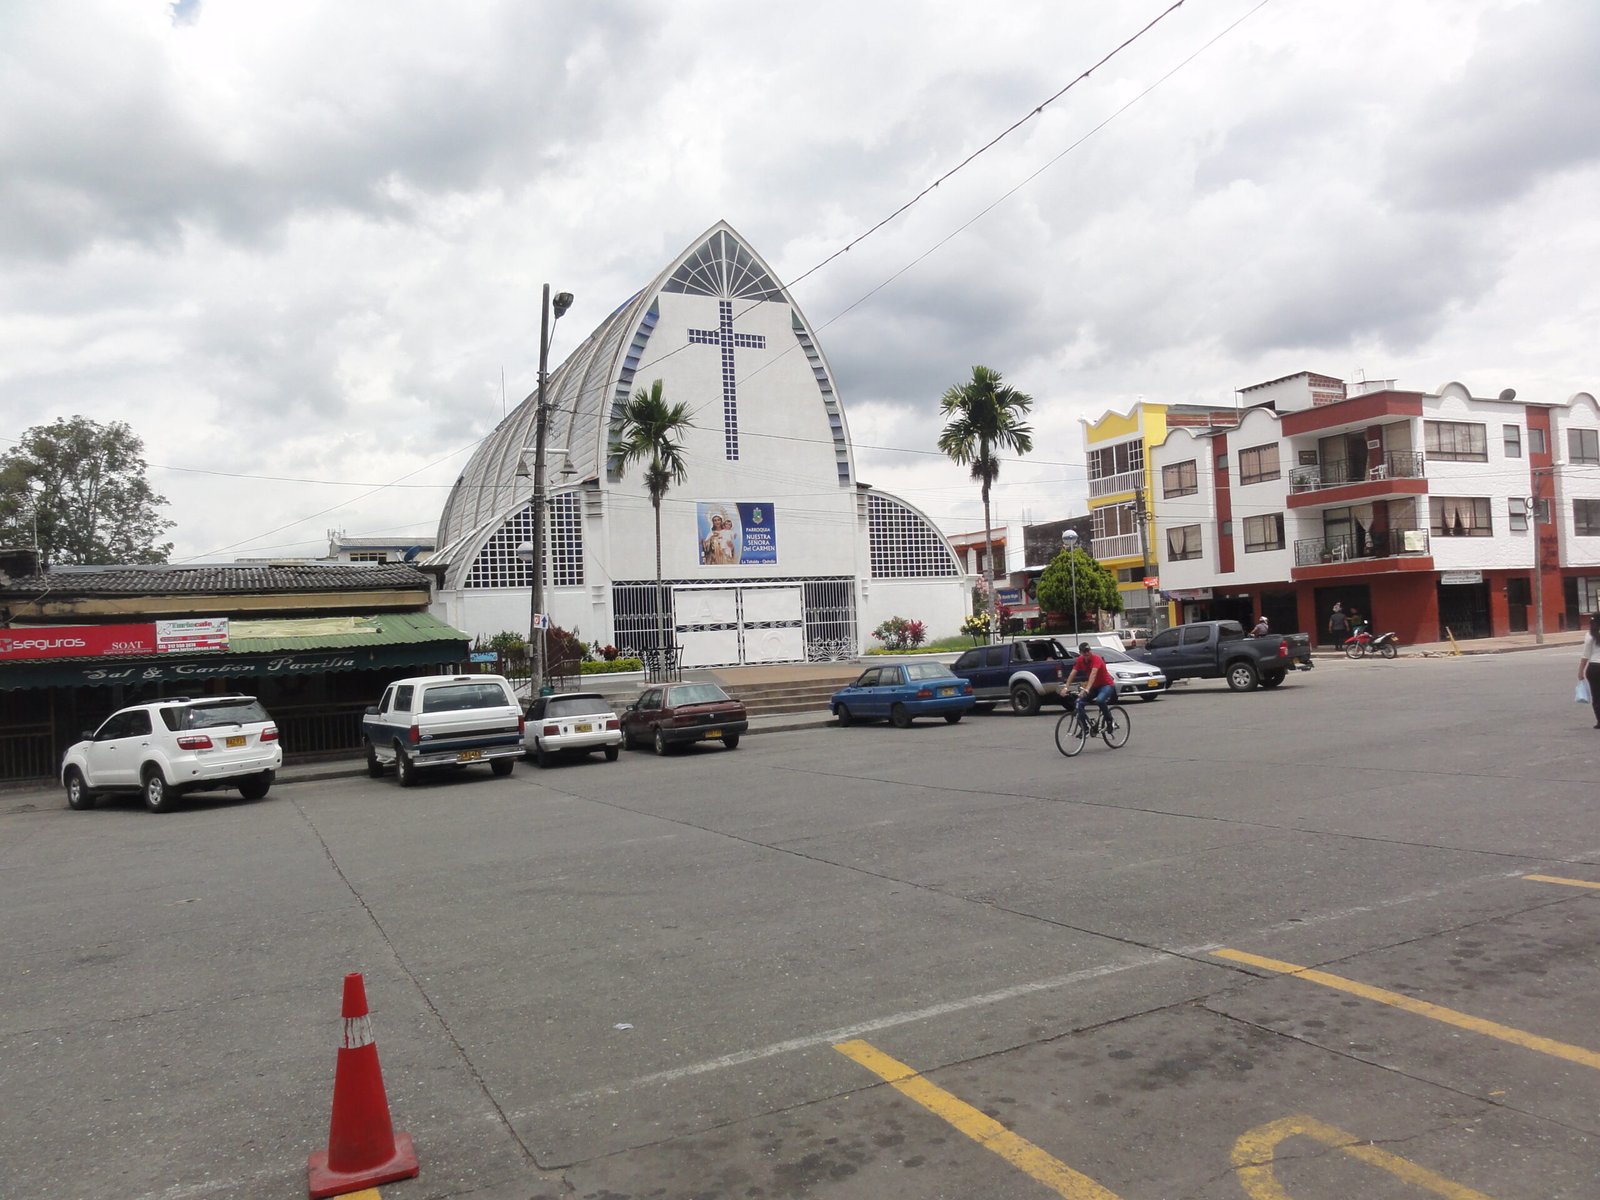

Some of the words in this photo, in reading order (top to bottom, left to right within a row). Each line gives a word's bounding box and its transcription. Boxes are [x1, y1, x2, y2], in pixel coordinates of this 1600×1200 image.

[13, 638, 86, 651] seguros
[112, 641, 144, 650] SOAT
[82, 668, 136, 680] Sal
[142, 667, 163, 679] &
[170, 664, 256, 674] Carbón
[267, 656, 354, 671] Parrilla
